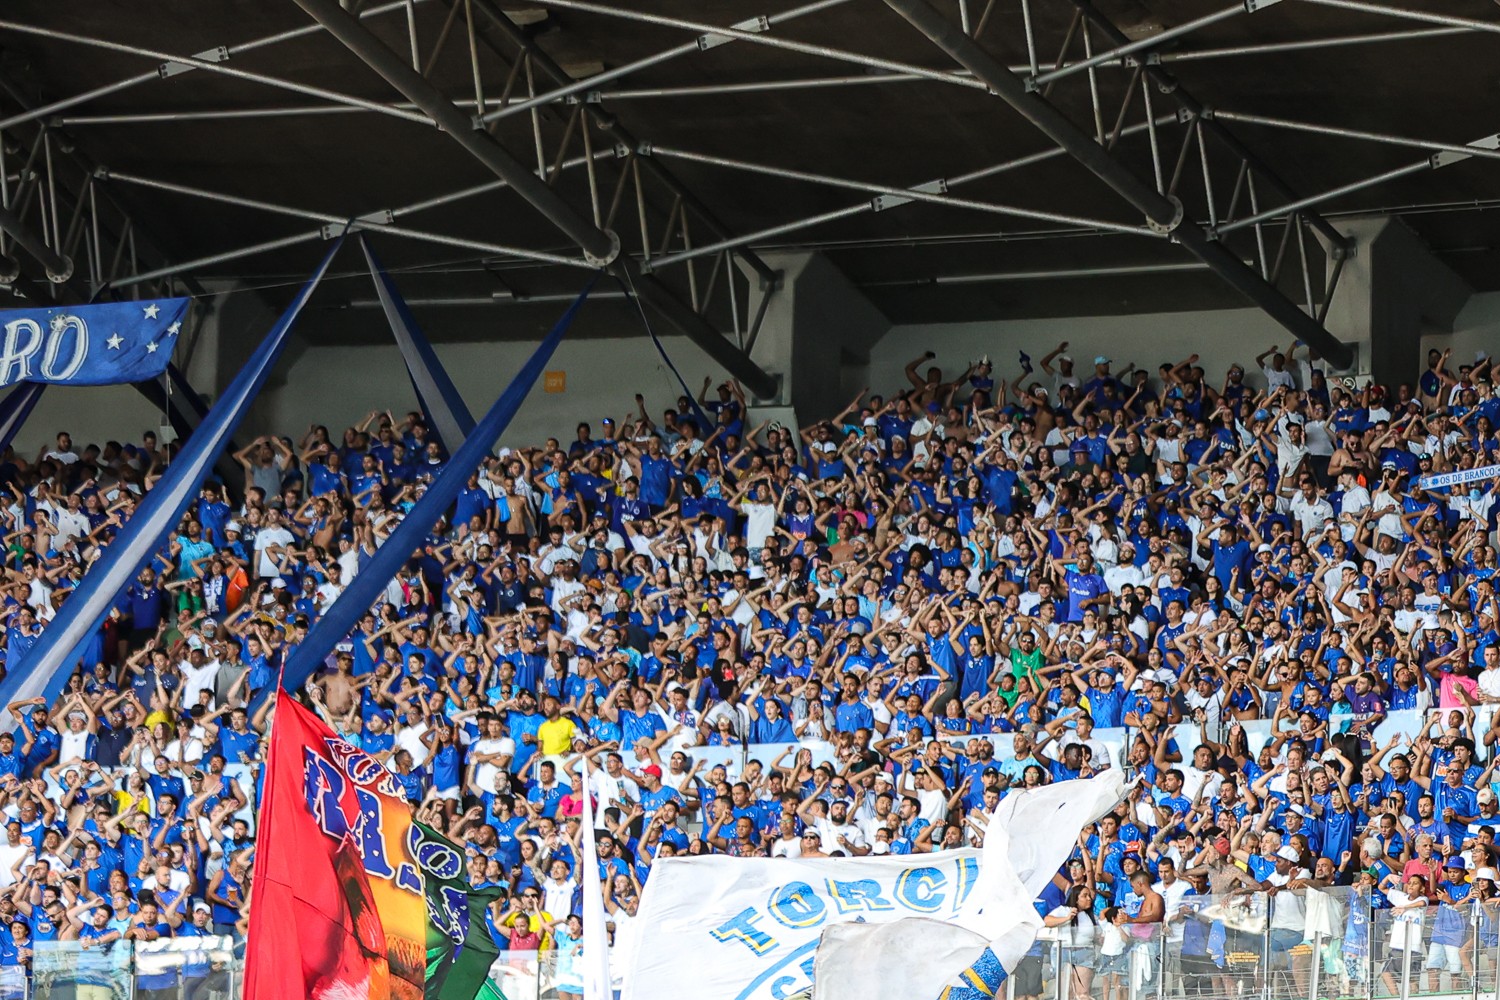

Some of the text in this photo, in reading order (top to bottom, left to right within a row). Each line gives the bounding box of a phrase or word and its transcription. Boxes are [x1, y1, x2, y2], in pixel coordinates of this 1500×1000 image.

[1440, 467, 1495, 485] OS DE BRANCO
